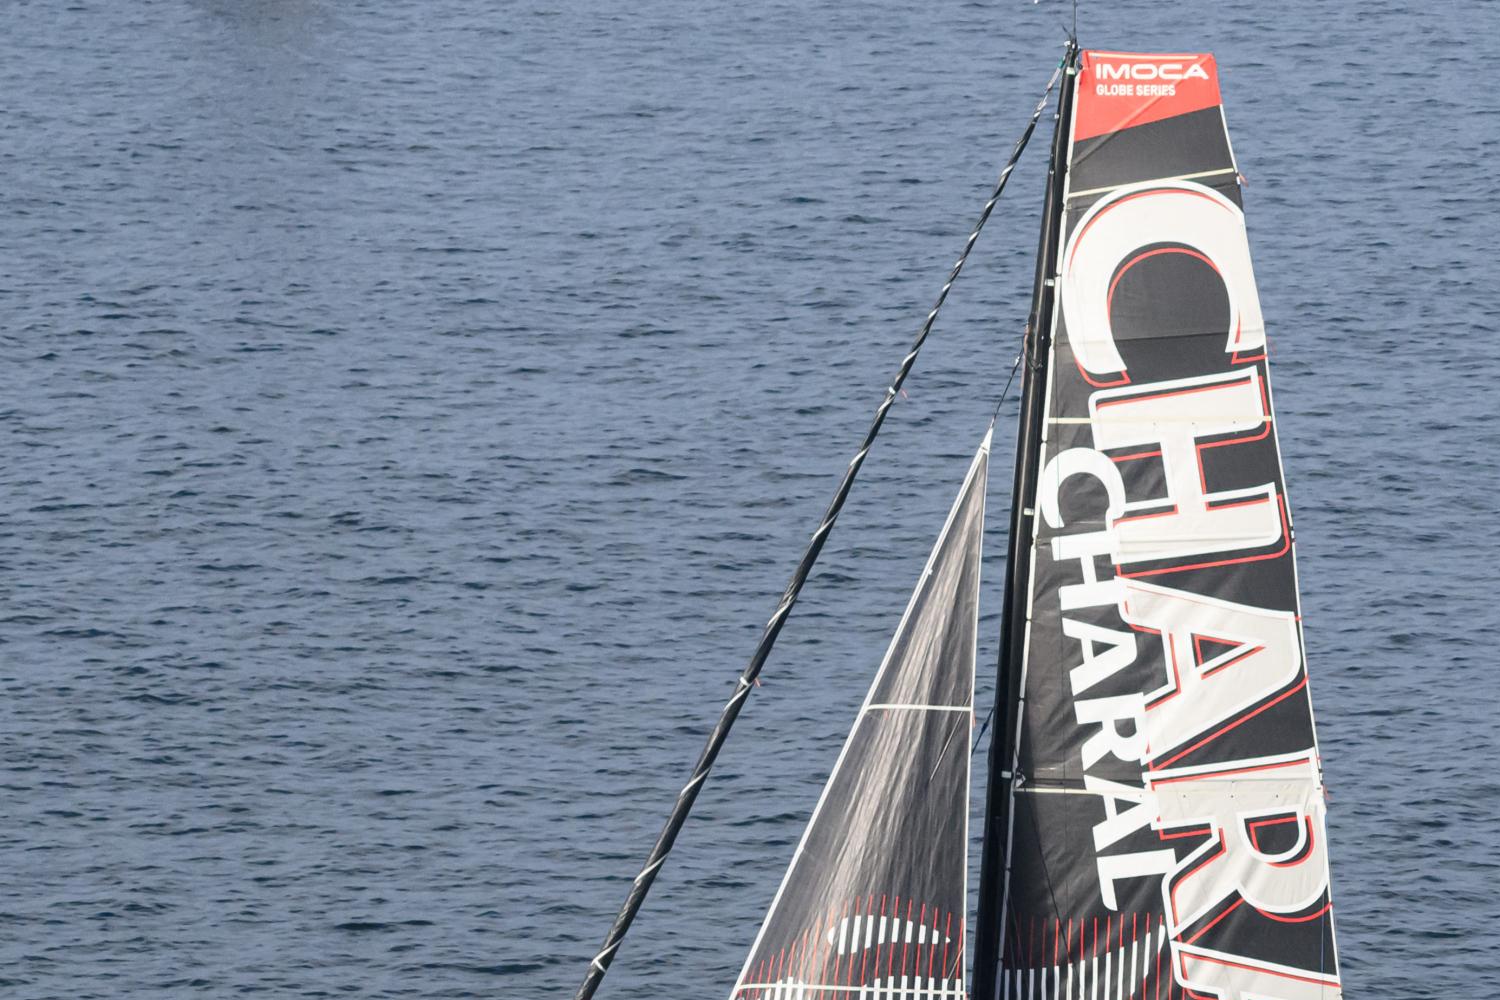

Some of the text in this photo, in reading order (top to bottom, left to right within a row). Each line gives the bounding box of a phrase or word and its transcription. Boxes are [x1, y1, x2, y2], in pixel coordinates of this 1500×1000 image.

[1096, 63, 1209, 80] IMOCA
[1096, 84, 1176, 97] GLOBE SERIES
[1039, 447, 1180, 911] CHARAL
